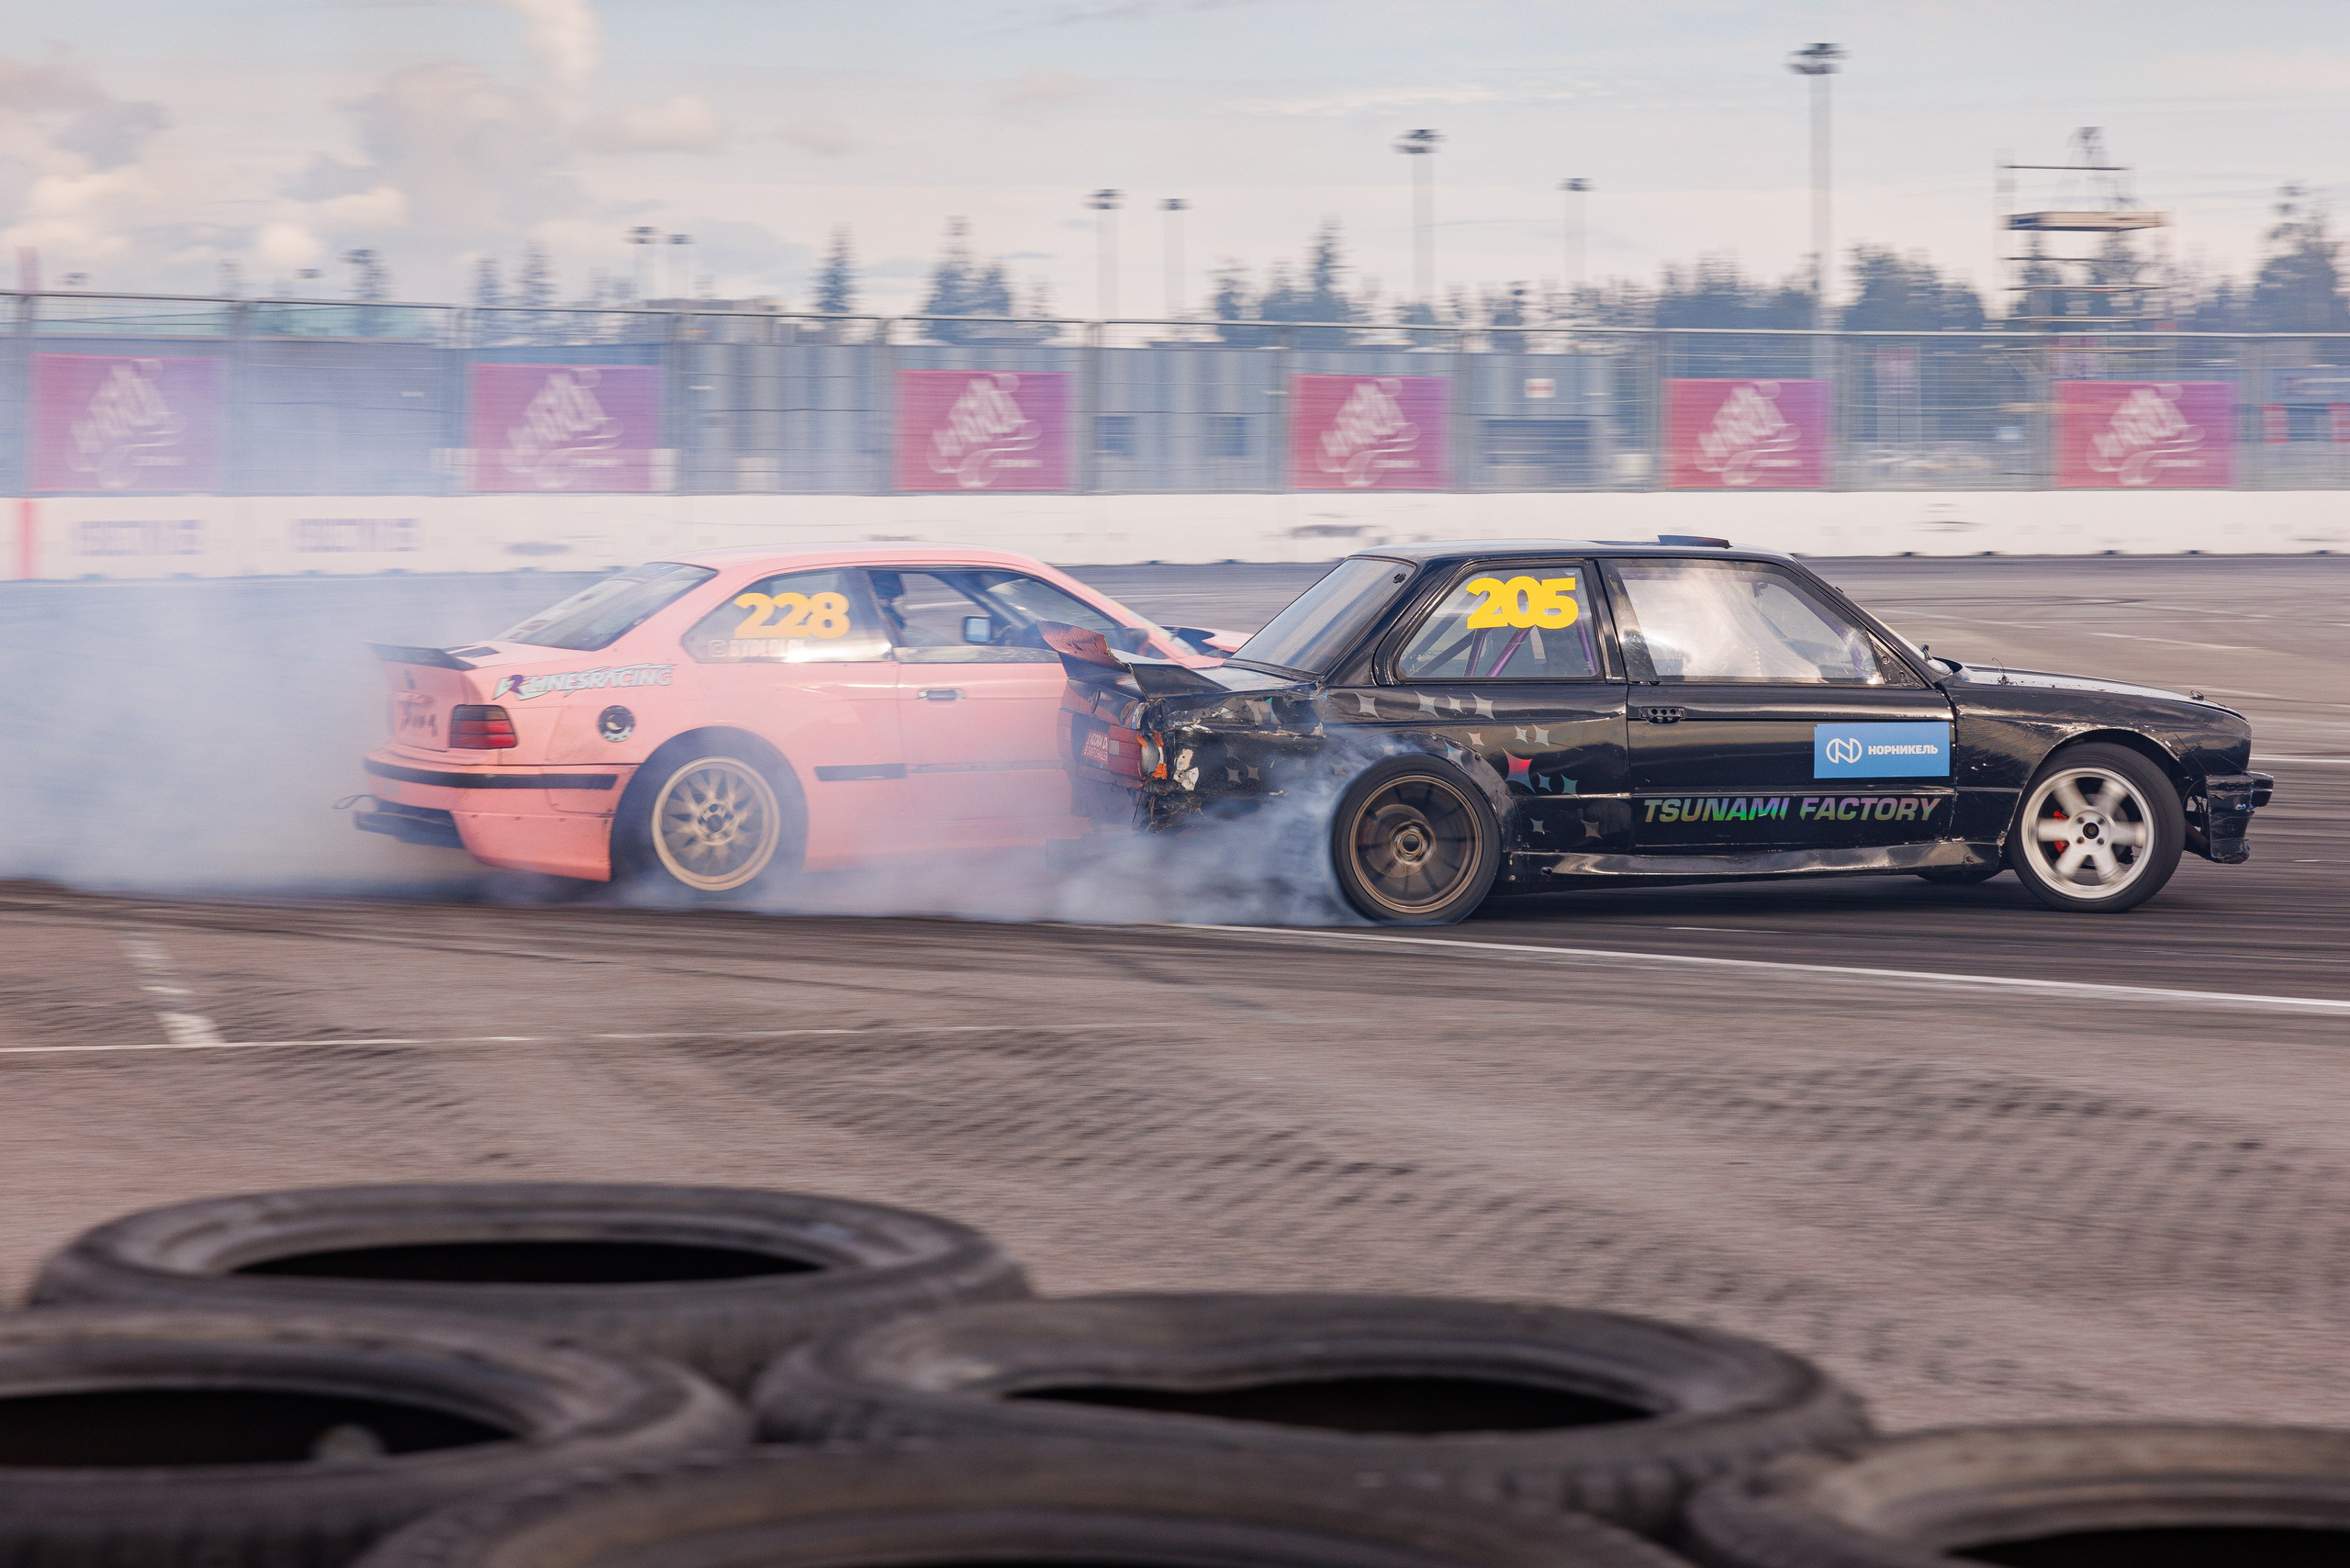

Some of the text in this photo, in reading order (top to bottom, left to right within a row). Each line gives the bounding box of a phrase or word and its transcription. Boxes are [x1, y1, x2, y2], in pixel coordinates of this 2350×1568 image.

[733, 592, 851, 639] 228
[1465, 576, 1579, 630] 205
[1868, 745, 1939, 756] НОРНИКЕЛЬ
[1644, 797, 1942, 823] TSUNAMI FACTORY
